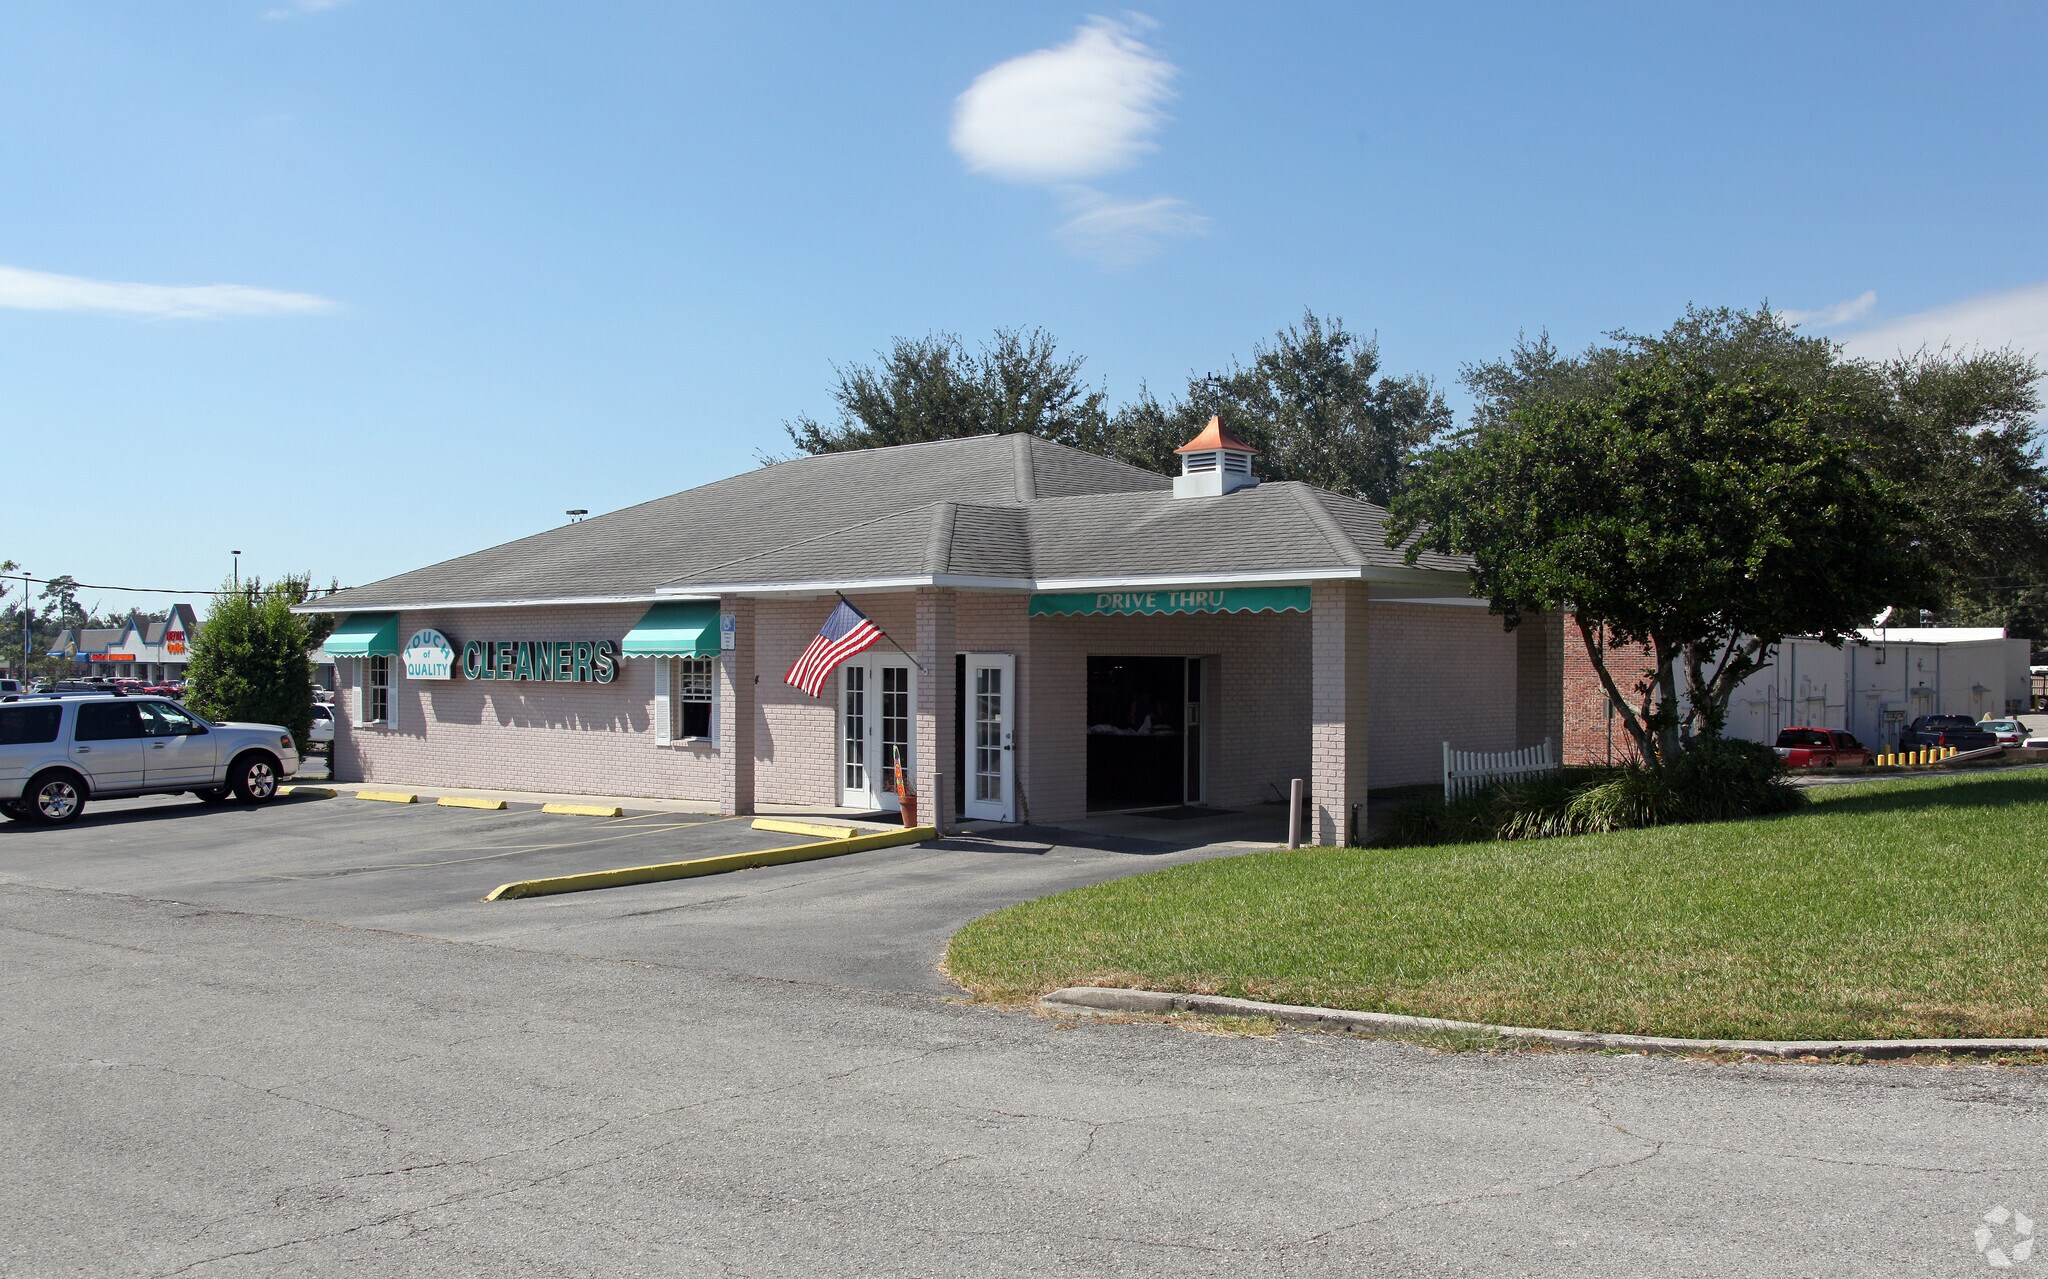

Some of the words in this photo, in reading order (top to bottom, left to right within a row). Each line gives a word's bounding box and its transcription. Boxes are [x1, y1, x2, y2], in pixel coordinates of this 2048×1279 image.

[1096, 593, 1156, 608] DRIVE
[1168, 591, 1224, 607] THRU
[405, 631, 450, 660] TOUCH
[423, 650, 431, 658] of
[408, 663, 448, 676] QUALITY
[463, 640, 616, 684] CLEANERS
